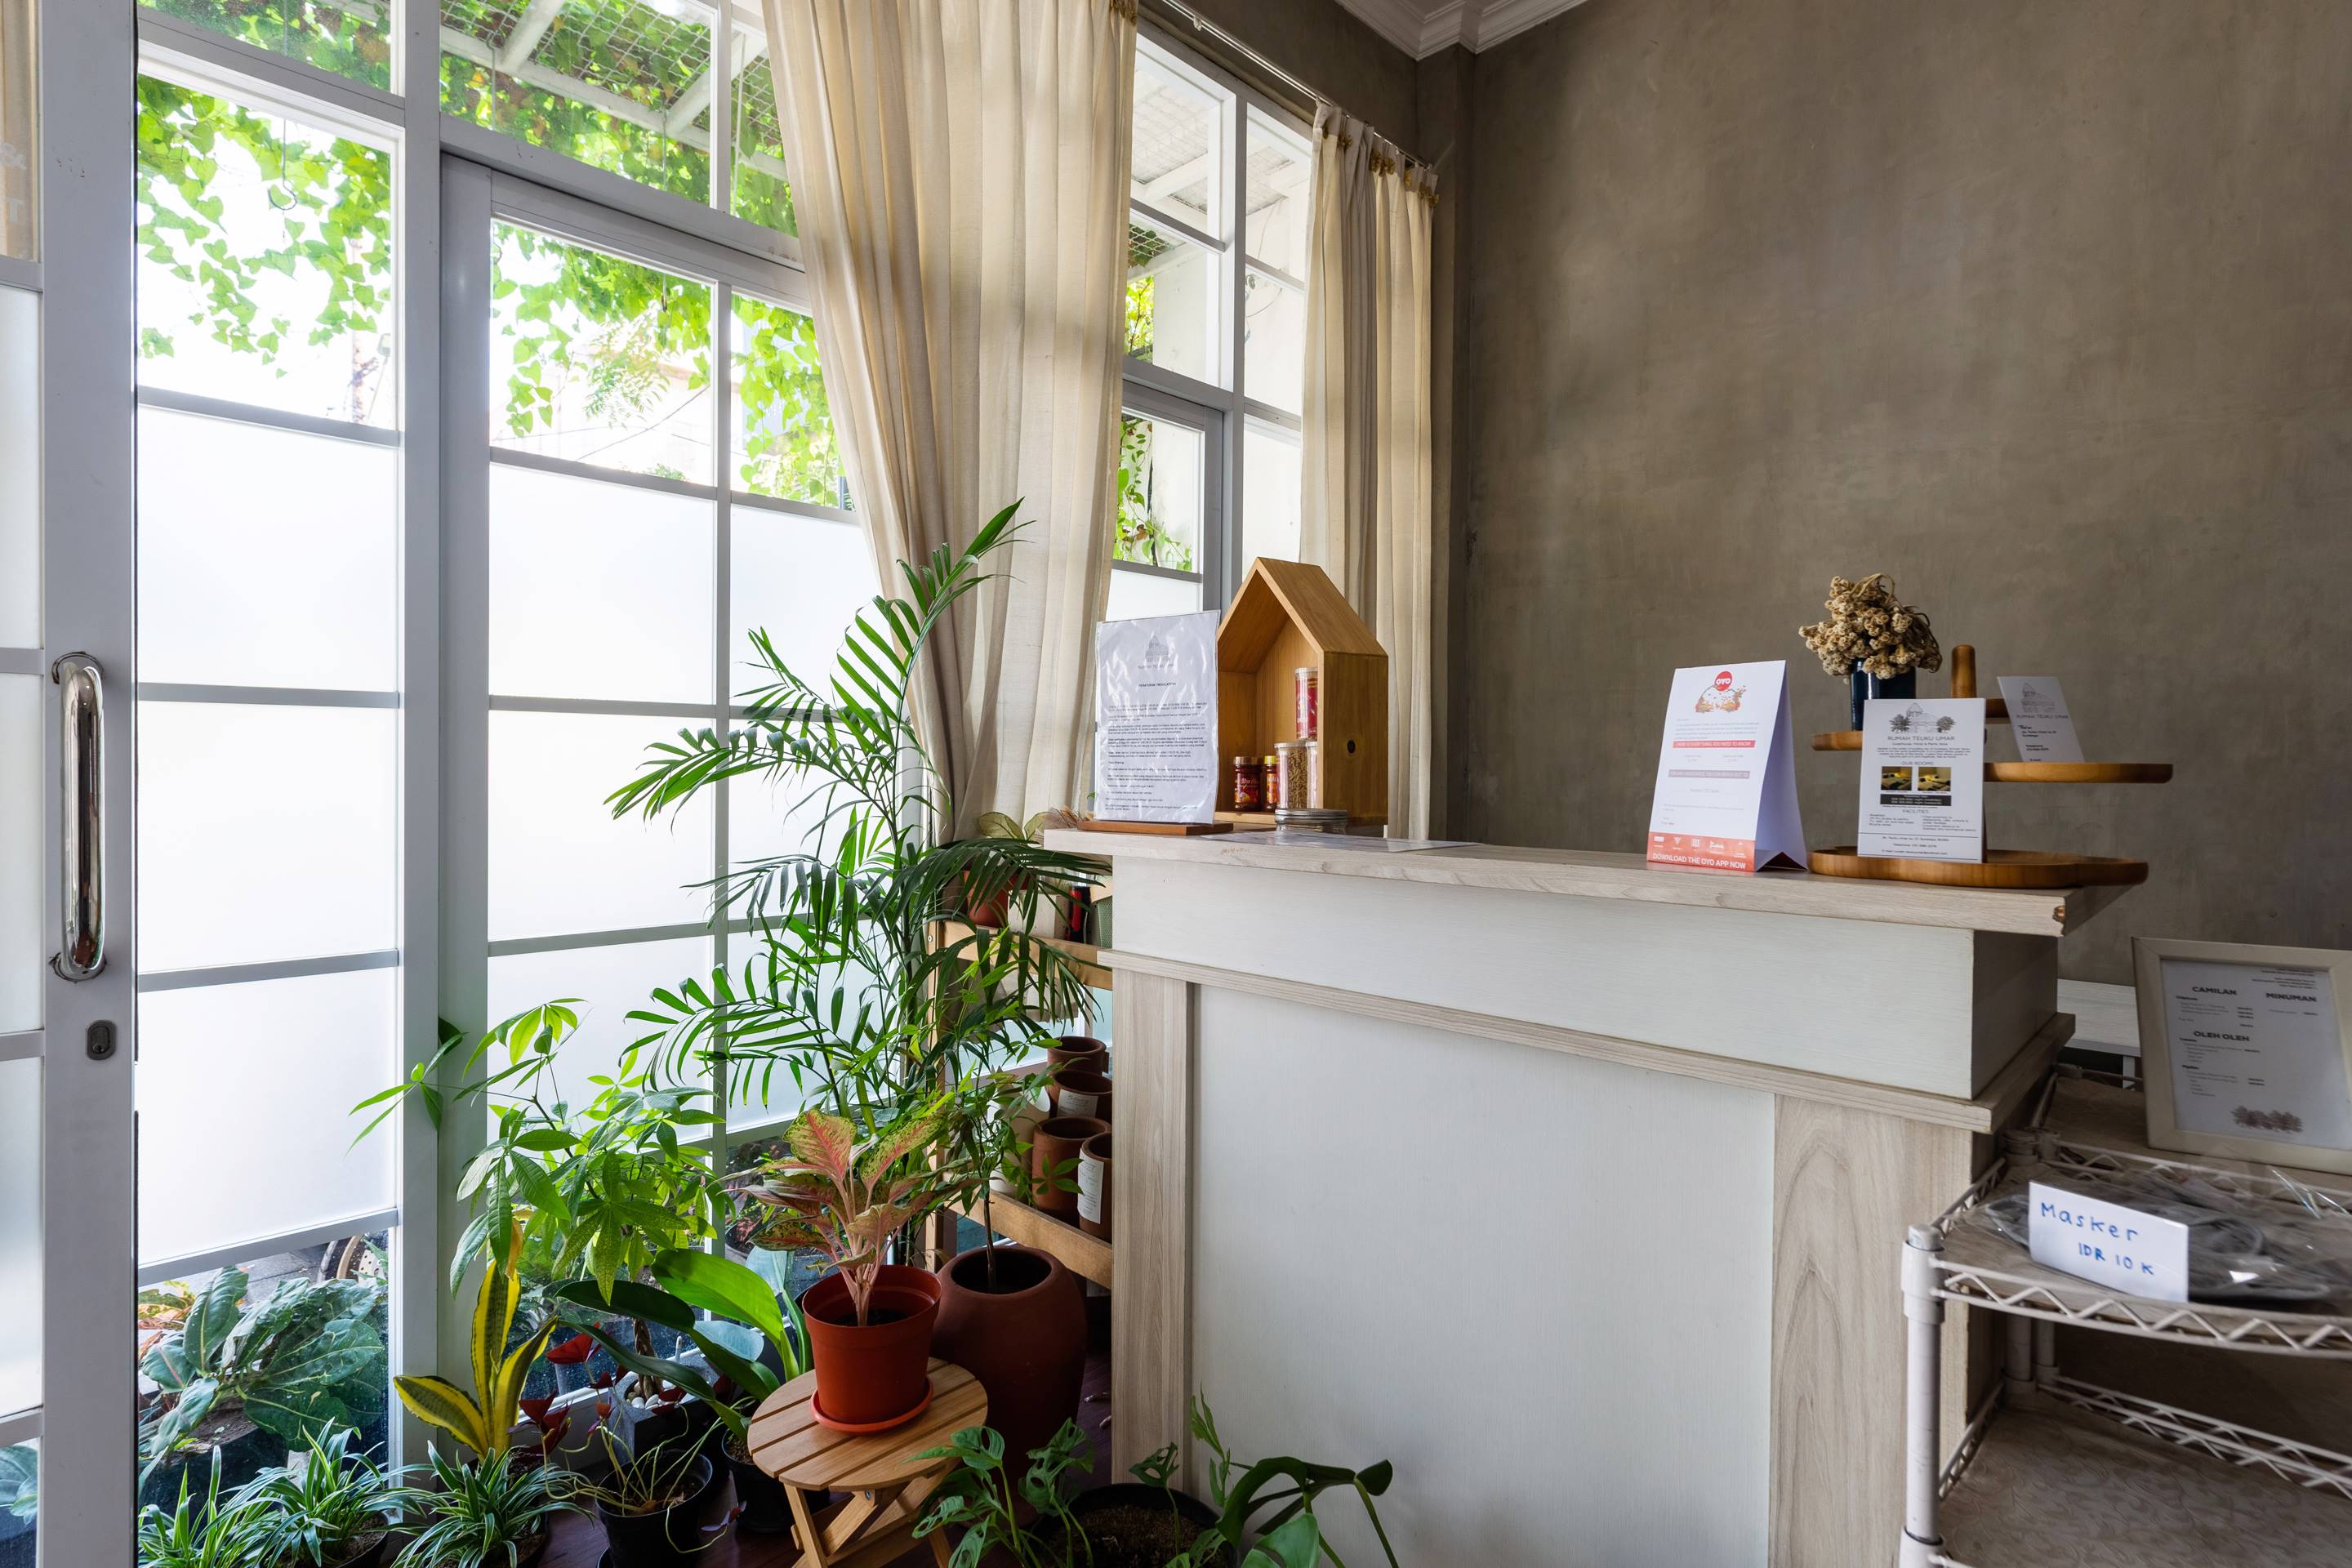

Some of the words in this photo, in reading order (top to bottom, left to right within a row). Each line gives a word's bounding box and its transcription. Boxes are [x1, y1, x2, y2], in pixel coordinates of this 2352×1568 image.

[1652, 853, 1686, 862] DOWNLOAD
[2192, 986, 2238, 996] CAMILAN
[2265, 992, 2318, 1003] MINUMAN
[2194, 1030, 2221, 1039] OLEH
[2222, 1033, 2250, 1041] OLEH
[2041, 1201, 2138, 1241] Masker
[2078, 1242, 2106, 1262] IDR
